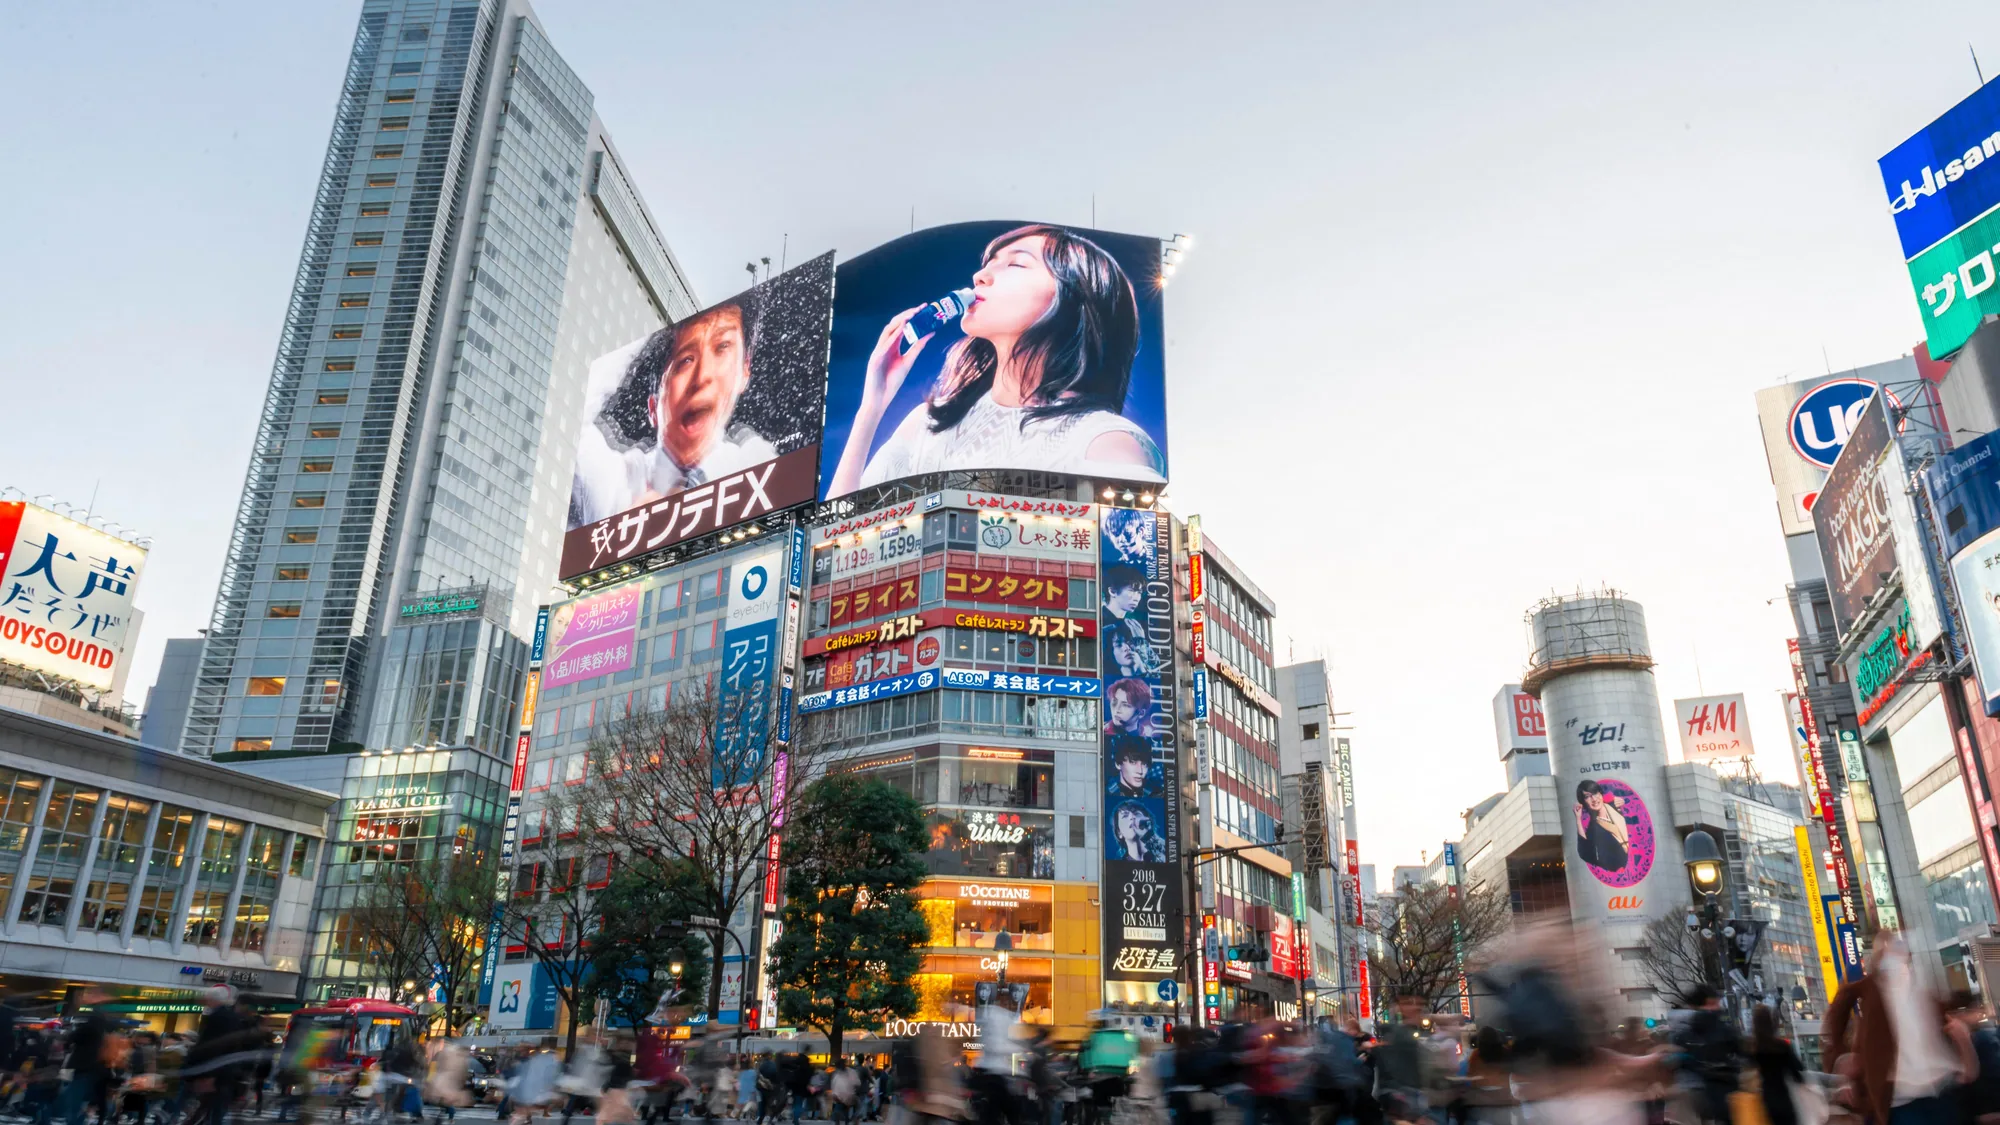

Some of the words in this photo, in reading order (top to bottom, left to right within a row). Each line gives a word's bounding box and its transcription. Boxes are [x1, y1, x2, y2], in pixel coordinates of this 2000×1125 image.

[1921, 242, 2000, 317] サロ
[1950, 445, 1992, 477] Channel
[967, 493, 1090, 517] しゃぶしゃぶバイキング
[1829, 499, 1849, 538] back
[1847, 454, 1875, 512] number
[617, 463, 776, 558] サンテFX
[824, 501, 916, 539] しゃぶしゃぶバイキング
[1018, 524, 1091, 550] しゃぶ葉
[1157, 517, 1168, 550] BULLET
[12, 532, 136, 597] 大声
[815, 556, 831, 572] 9F
[1158, 553, 1169, 580] TRAIN
[422, 594, 459, 602] SHIBUYA
[947, 572, 1063, 601] コンタクト
[401, 603, 440, 614] MARK
[444, 598, 478, 609] CITY
[589, 594, 635, 615] 品川スキン
[733, 600, 772, 619] eyecity
[832, 580, 917, 620] プライス
[588, 610, 629, 632] クリニック
[879, 615, 924, 643] ガスト
[1028, 615, 1084, 638] ガスト
[1147, 582, 1173, 677] GOLDEN
[1194, 633, 1204, 658] ガスト
[556, 644, 628, 680] 品川美容外科
[854, 649, 909, 684] ガスト
[806, 667, 824, 687] 7F
[919, 674, 932, 686] 6F
[949, 672, 983, 685] AEON
[993, 674, 1098, 694] 英会話イーオン
[1149, 683, 1176, 764] EPOCH
[1521, 716, 1546, 734] QL
[1565, 717, 1578, 729] イチ
[1686, 701, 1737, 736] H&M
[1578, 722, 1626, 746] ゼロ!
[1340, 743, 1348, 760] BIC
[1620, 744, 1645, 753] キュー
[1696, 741, 1728, 752] 150m
[1580, 766, 1591, 774] au
[1592, 760, 1630, 771] ゼロ学割
[376, 787, 428, 796] SHIBUYA
[1341, 763, 1353, 808] CAMERA
[351, 796, 403, 810] MARK
[410, 795, 455, 806] CITY
[1168, 813, 1176, 837] SUPER
[1132, 869, 1157, 883] 2019.
[960, 885, 1031, 899] L'OCCITANE
[1123, 882, 1167, 912] 3.27
[1607, 895, 1643, 910] au
[1808, 878, 1823, 925] Matsumoto
[1123, 912, 1137, 926] ON
[1139, 913, 1166, 927] SALE
[1275, 937, 1291, 956] アコム
[1844, 931, 1857, 966] MIZUHO
[1113, 947, 1178, 973] 超特急
